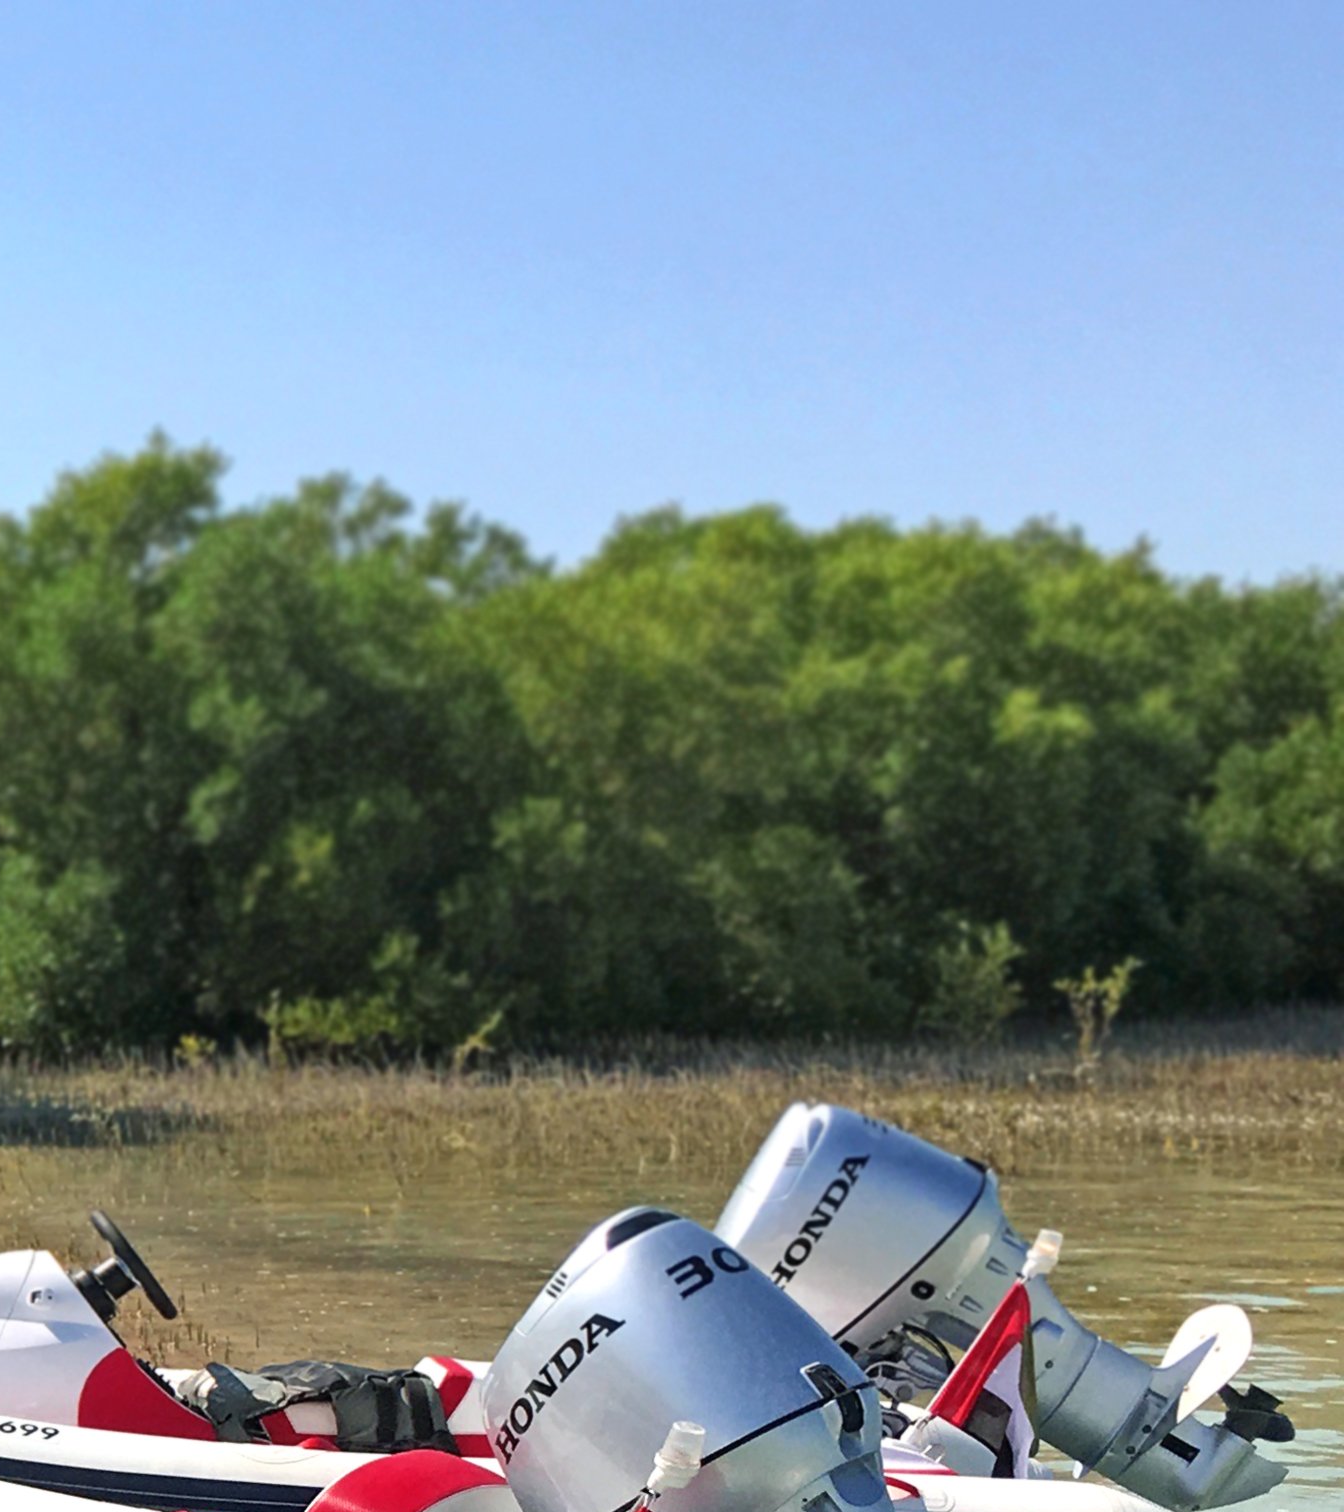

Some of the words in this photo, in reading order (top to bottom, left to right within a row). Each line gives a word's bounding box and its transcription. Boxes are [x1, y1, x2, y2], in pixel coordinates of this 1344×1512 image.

[665, 1246, 750, 1300] 30
[771, 1154, 871, 1291] HONDA
[495, 1313, 626, 1465] HONDA
